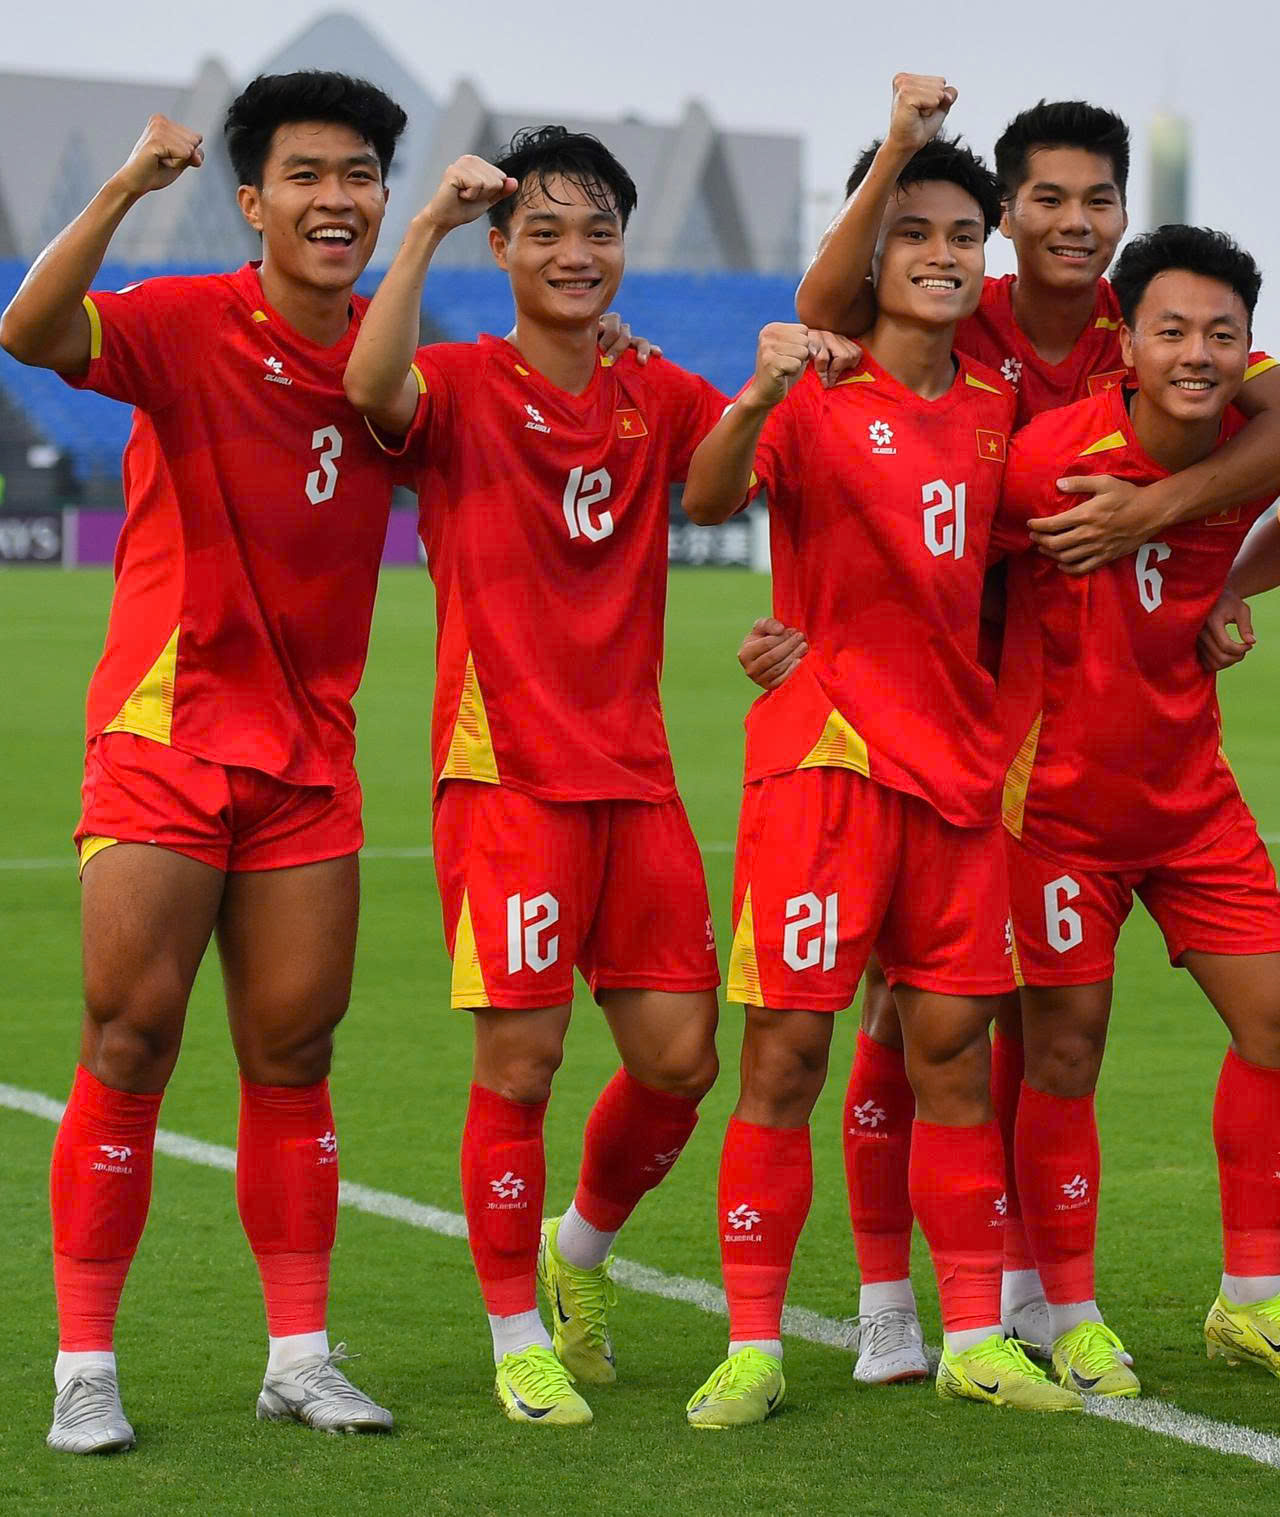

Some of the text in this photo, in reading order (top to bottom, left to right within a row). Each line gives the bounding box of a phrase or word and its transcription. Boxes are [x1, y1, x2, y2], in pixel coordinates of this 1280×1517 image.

[305, 426, 342, 504] 3
[563, 466, 613, 542] 12
[922, 479, 965, 559] 21
[1136, 542, 1172, 613] 6
[507, 892, 558, 974] 12
[783, 892, 837, 972] 21
[1044, 875, 1082, 953] 6
